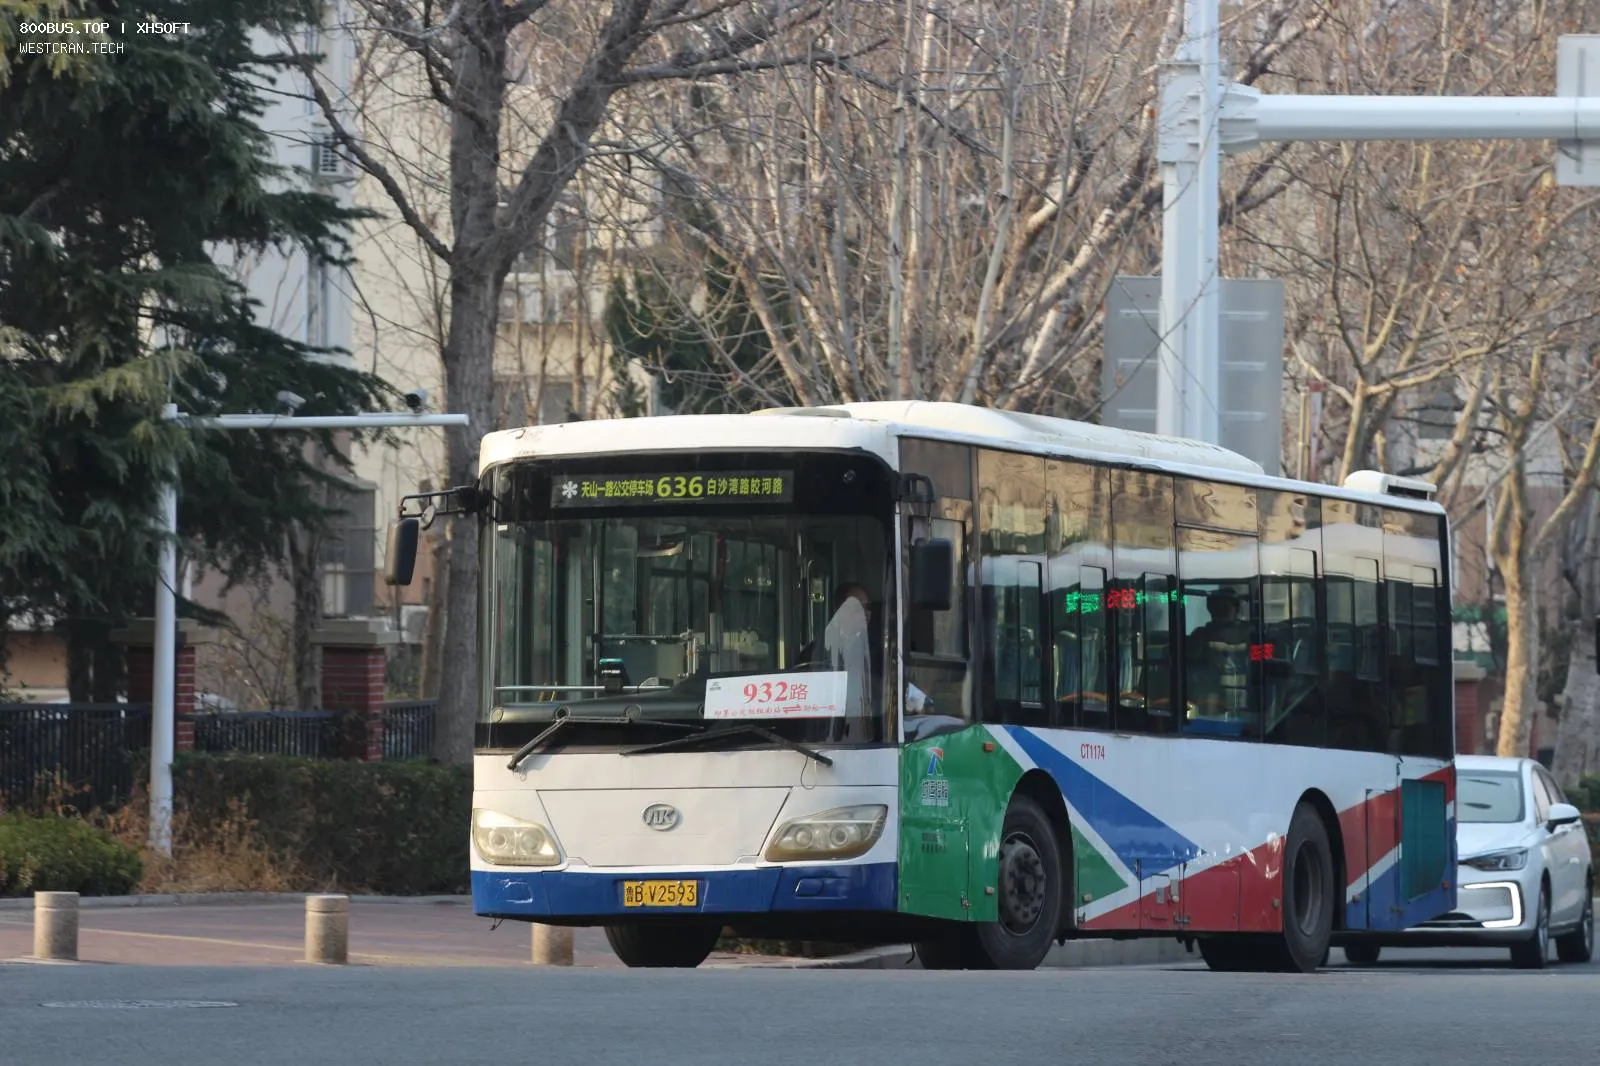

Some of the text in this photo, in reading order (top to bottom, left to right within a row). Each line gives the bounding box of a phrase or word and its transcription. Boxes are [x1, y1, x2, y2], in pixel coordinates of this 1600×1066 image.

[581, 480, 654, 497] 天山一路公交停车场
[656, 476, 703, 497] 636
[743, 681, 808, 703] 932路
[1080, 743, 1105, 760] CT1174
